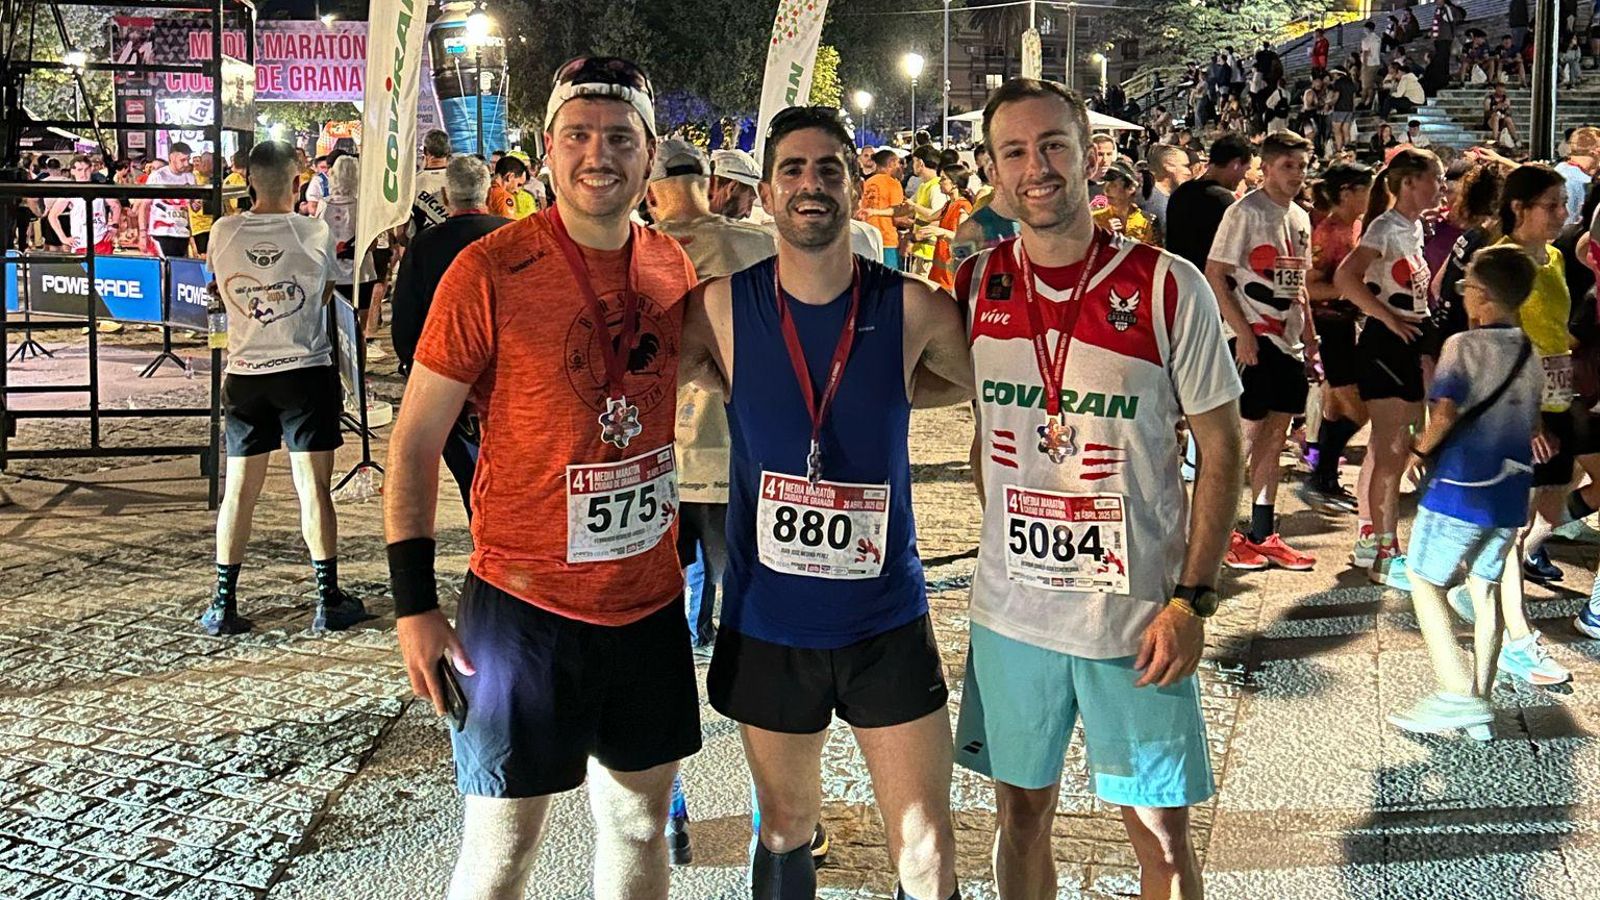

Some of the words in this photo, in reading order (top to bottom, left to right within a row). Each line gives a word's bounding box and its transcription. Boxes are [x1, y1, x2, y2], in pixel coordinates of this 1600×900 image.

[188, 31, 259, 61] MDI
[265, 30, 367, 61] MARATÓN
[255, 65, 282, 92] DE
[289, 65, 365, 92] GRANA
[42, 275, 143, 299] POWERADE
[177, 283, 208, 307] POWE
[572, 470, 594, 492] 41
[765, 478, 785, 500] 41
[785, 482, 804, 494] MEDIA
[587, 484, 657, 533] 575
[784, 492, 803, 504] CIUDAD
[803, 495, 810, 504] DE
[810, 496, 835, 507] GRANADA
[773, 506, 852, 550] 880
[1009, 518, 1105, 562] 5084
